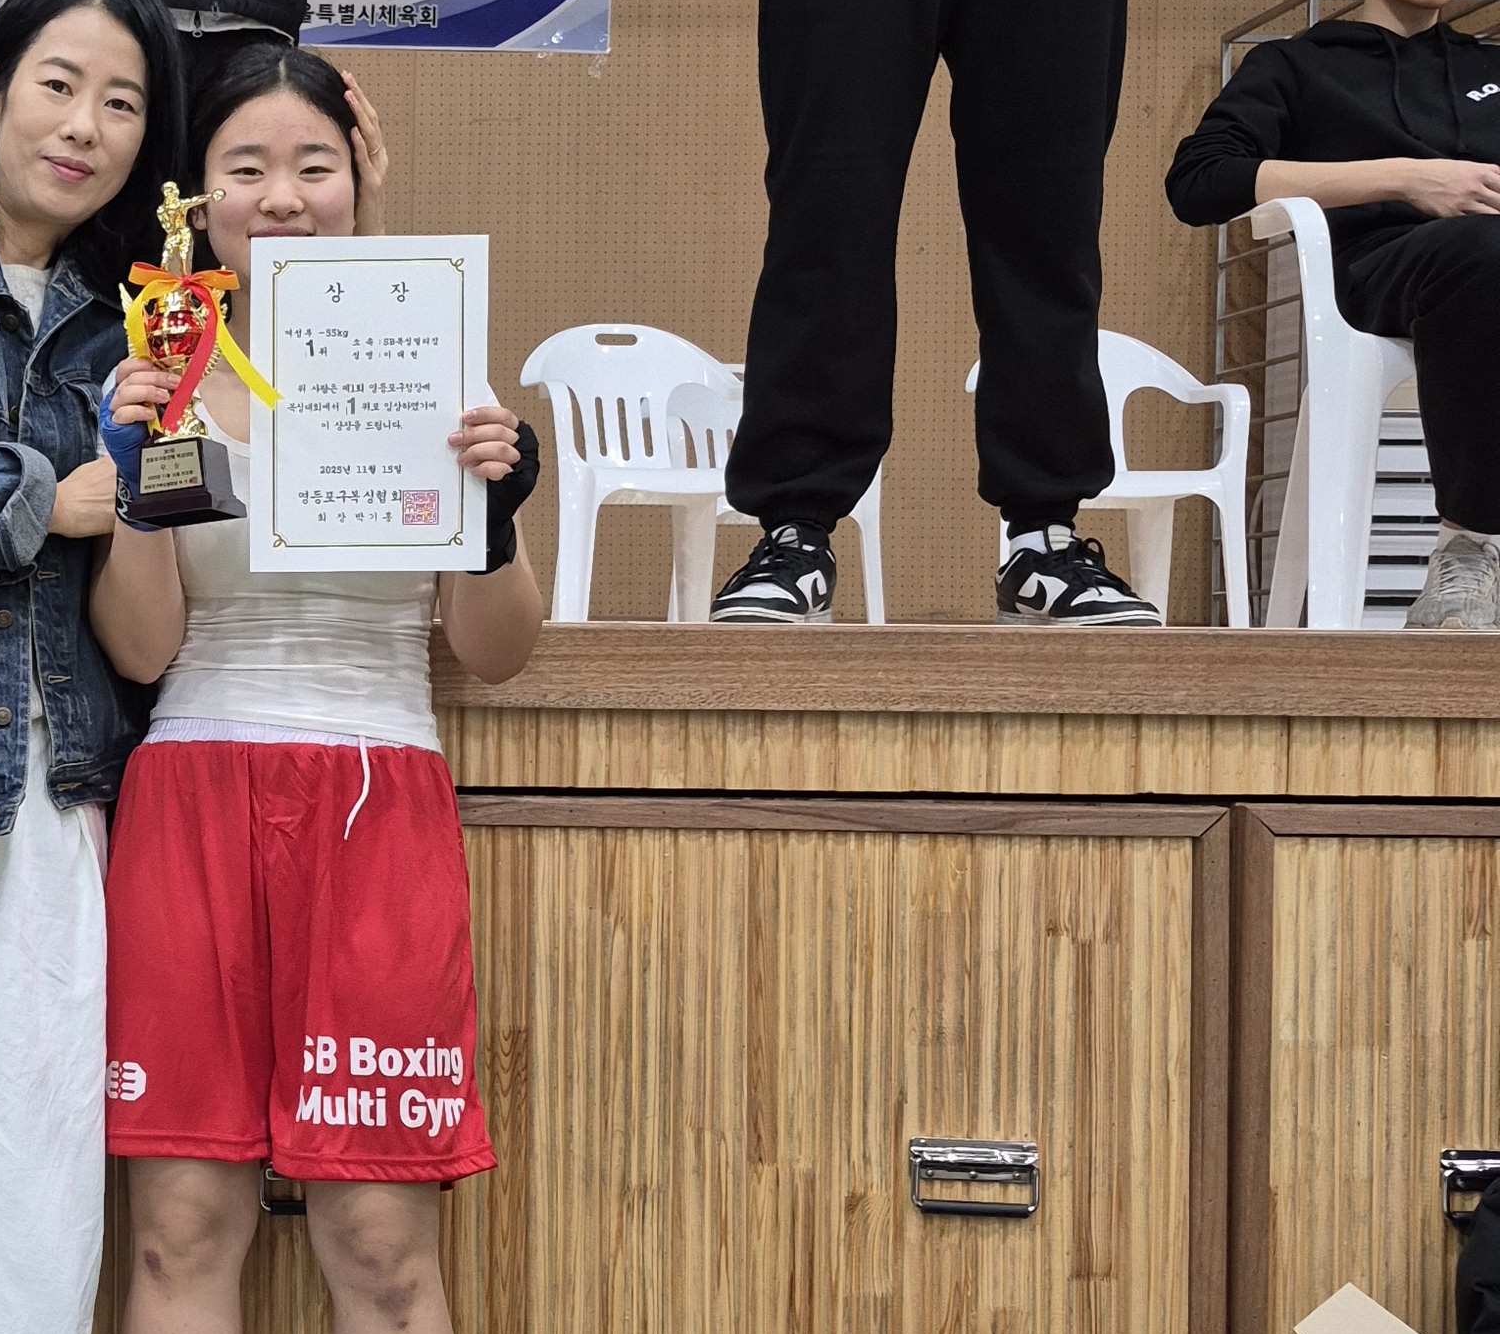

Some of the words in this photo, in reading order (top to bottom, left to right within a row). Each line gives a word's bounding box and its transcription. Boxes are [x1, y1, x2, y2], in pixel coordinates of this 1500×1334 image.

[324, 282, 345, 303] 상
[390, 282, 409, 303] 장
[305, 339, 315, 357] 1
[319, 464, 351, 475] 2025년
[350, 1037, 464, 1086] Boxing
[296, 1085, 387, 1127] Multi
